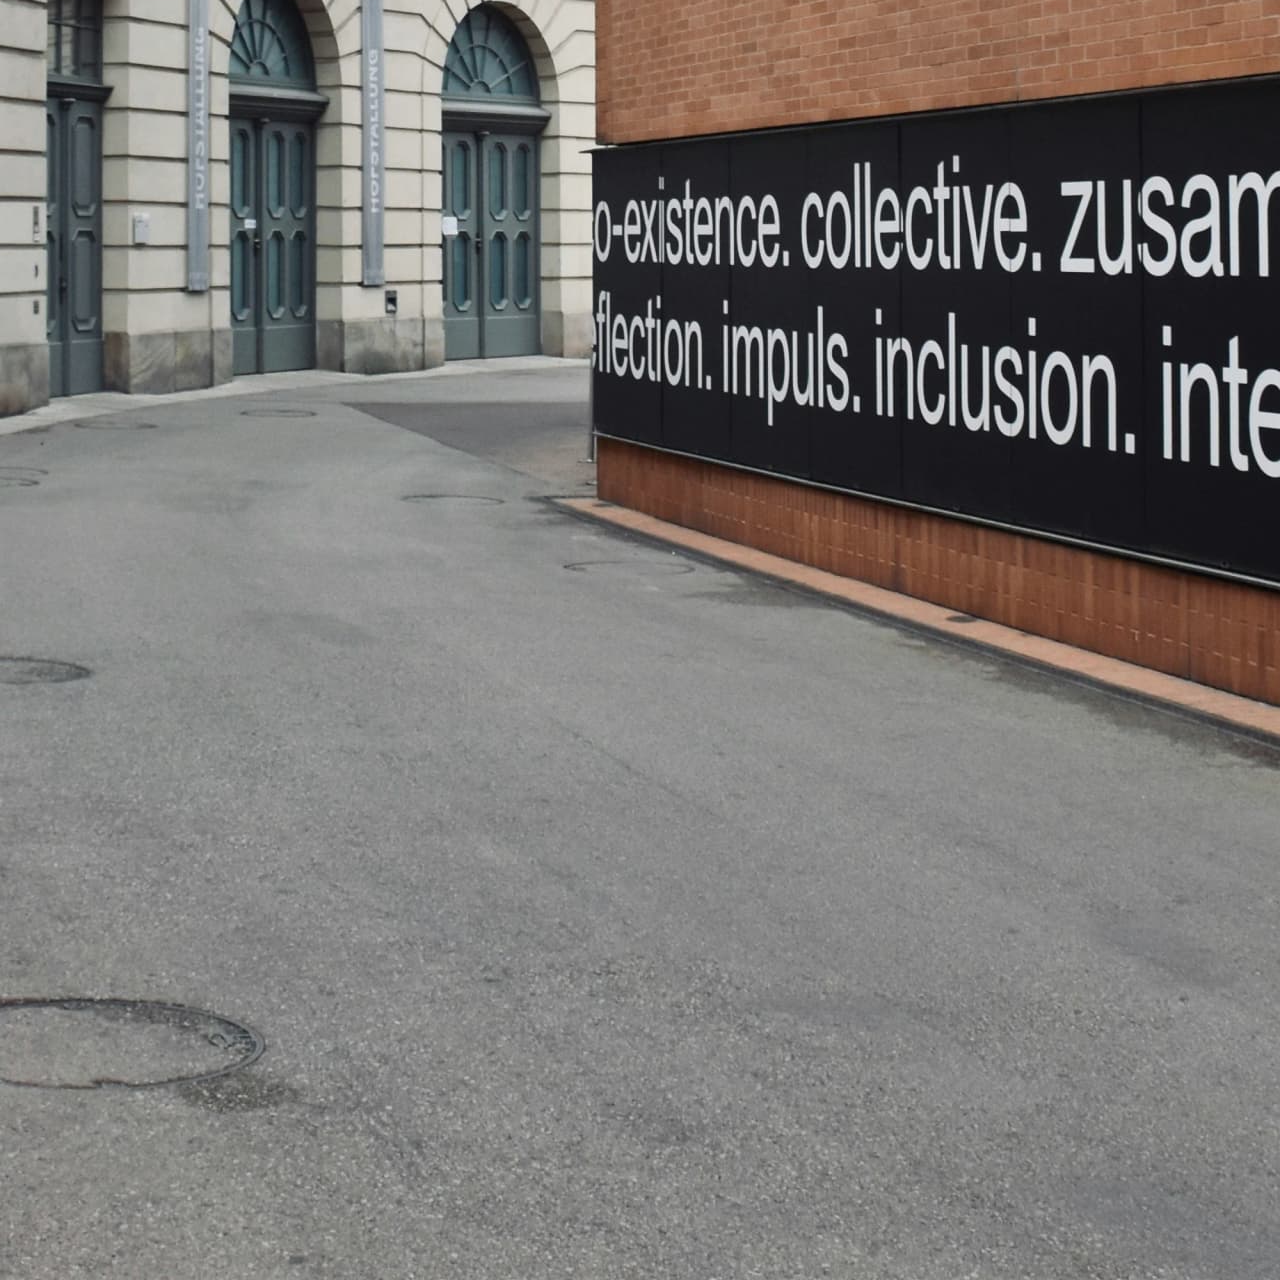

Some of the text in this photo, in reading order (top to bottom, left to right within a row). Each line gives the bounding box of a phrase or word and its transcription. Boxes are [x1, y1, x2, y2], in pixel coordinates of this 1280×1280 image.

[368, 48, 380, 214] HOFSTALLUNG
[592, 176, 790, 269] o-existence.
[800, 155, 1042, 273] collective.
[592, 290, 712, 391] flection.
[723, 299, 861, 427] impuls.
[875, 308, 1136, 455] inclusion.
